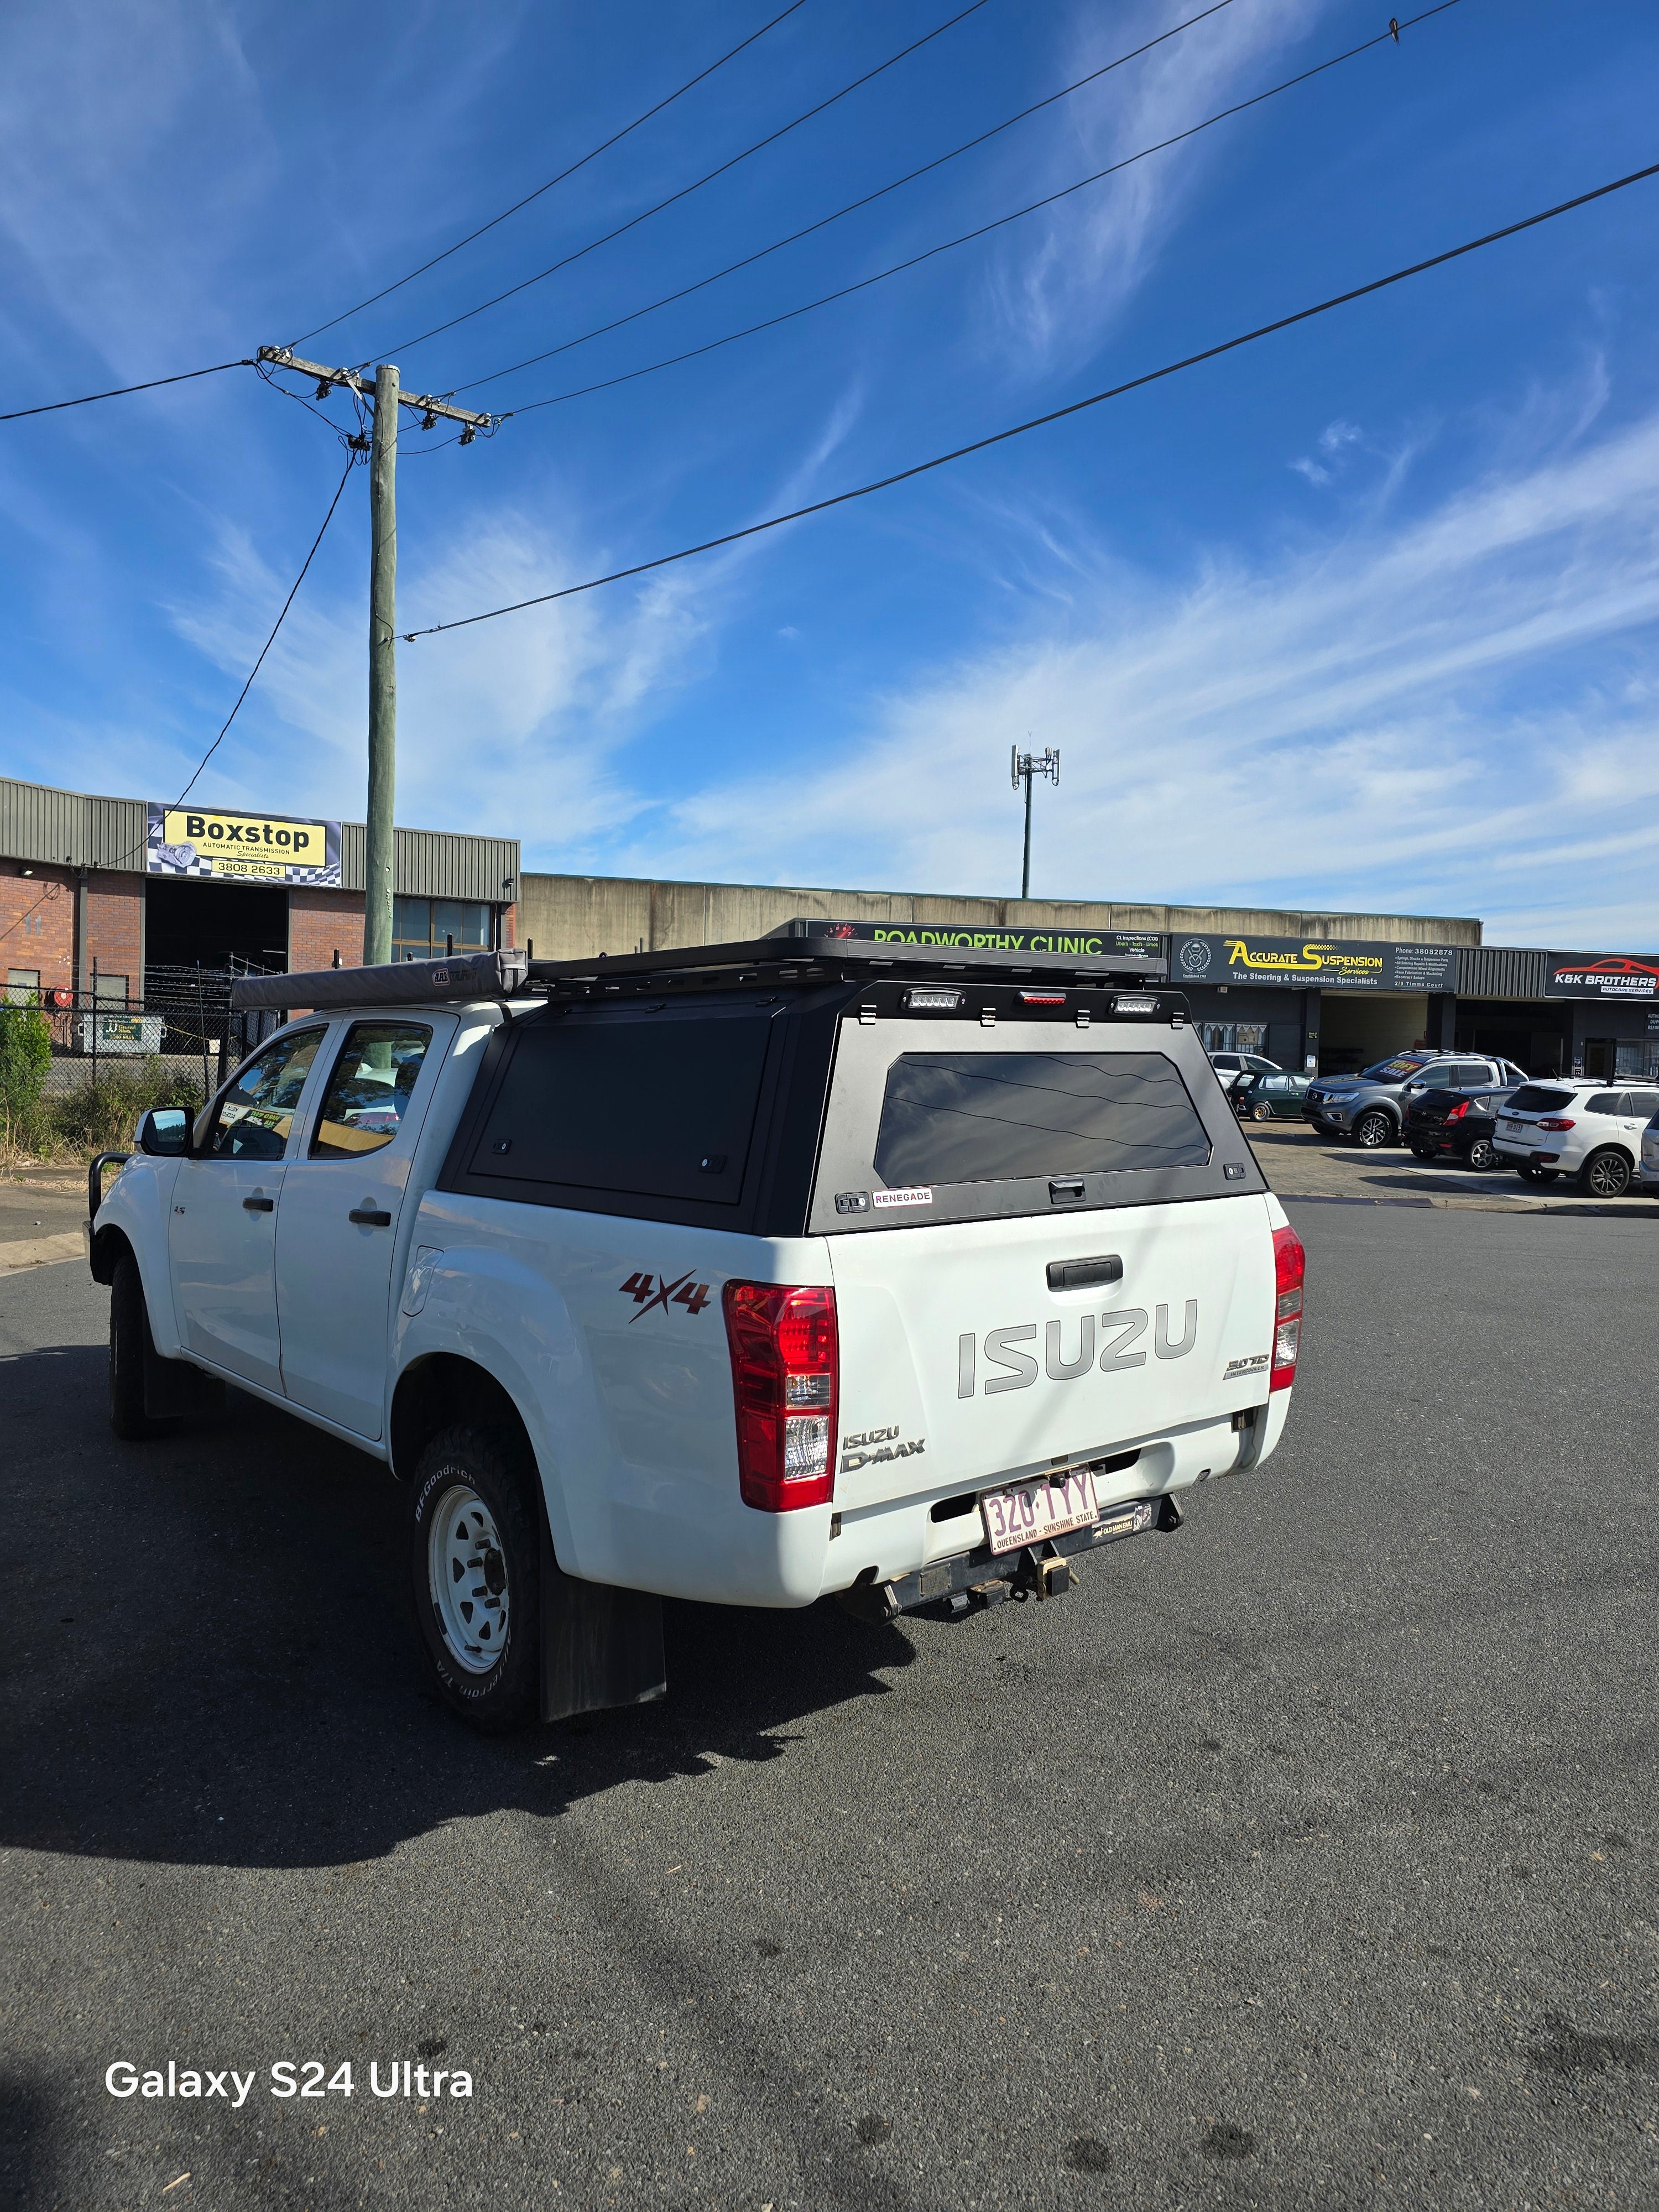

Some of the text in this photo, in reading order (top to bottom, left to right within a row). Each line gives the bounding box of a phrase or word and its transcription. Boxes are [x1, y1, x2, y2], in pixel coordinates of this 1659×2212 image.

[186, 815, 309, 852] Boxstop
[203, 842, 290, 854] AUTOMATIC TRANSMISSION
[218, 863, 280, 875] 3808 2633
[874, 930, 1103, 954] ROADWORTHY CLINIC
[1338, 967, 1369, 975] Services
[1249, 973, 1281, 983] Steering
[1291, 974, 1334, 983] Suspension
[1337, 976, 1378, 985] Specialists
[1555, 974, 1657, 987] K&K BROTHERS
[1387, 1060, 1419, 1071] EOFY
[1379, 1067, 1408, 1078] SALE
[875, 1192, 930, 1203] RENEGADE
[958, 1299, 1198, 1399] ISUZU
[1230, 1365, 1265, 1376] INTERCOOLER
[843, 1425, 899, 1450] ISUZU
[839, 1438, 926, 1474] D-MAX
[415, 1464, 476, 1522] BFGoodrich
[997, 1529, 1037, 1548] QUEENSLAND
[1043, 1517, 1074, 1534] SUNSHINE
[1076, 1511, 1094, 1524] STATE
[1103, 1526, 1113, 1535] OLD
[1123, 1521, 1133, 1529] EMU
